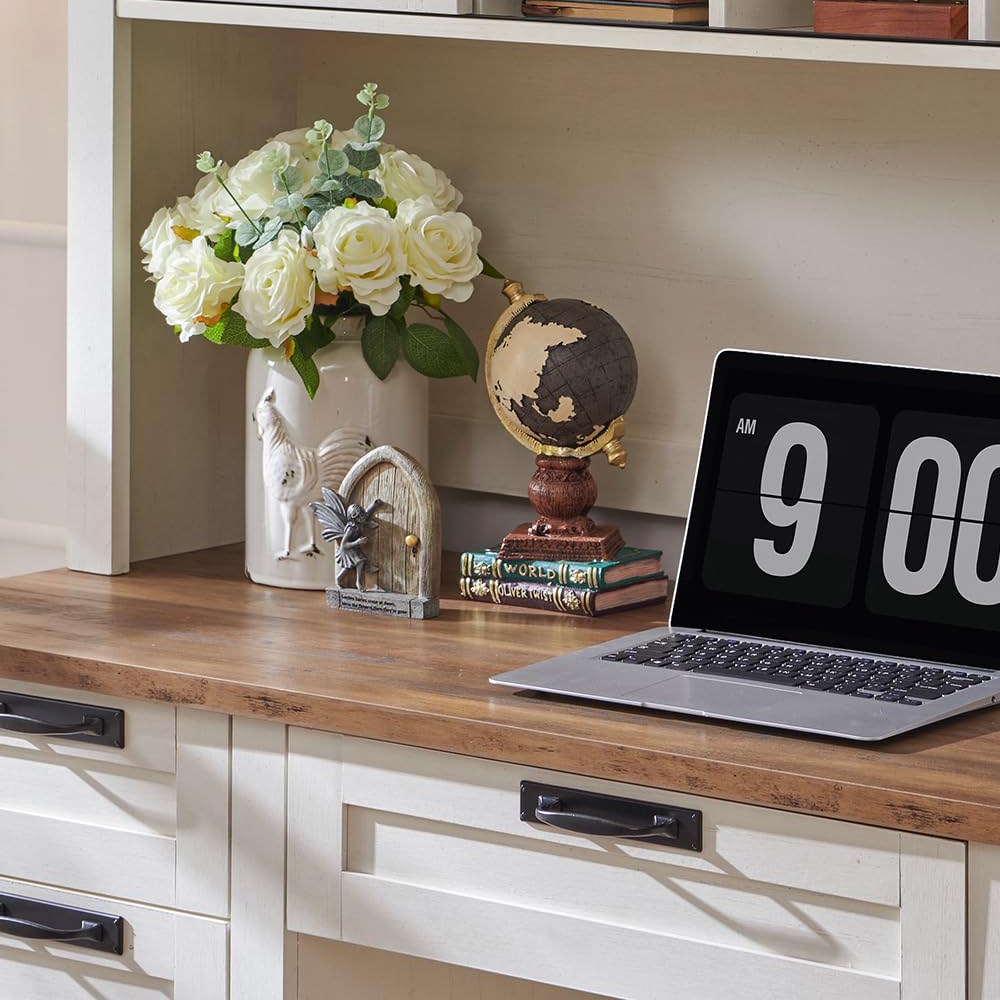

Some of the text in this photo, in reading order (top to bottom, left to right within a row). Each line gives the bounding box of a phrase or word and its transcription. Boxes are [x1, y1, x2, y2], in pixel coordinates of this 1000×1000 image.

[736, 417, 757, 435] AM
[753, 422, 828, 576] 9
[503, 563, 556, 580] WORLD
[498, 585, 553, 602] OLIVER TWIST
